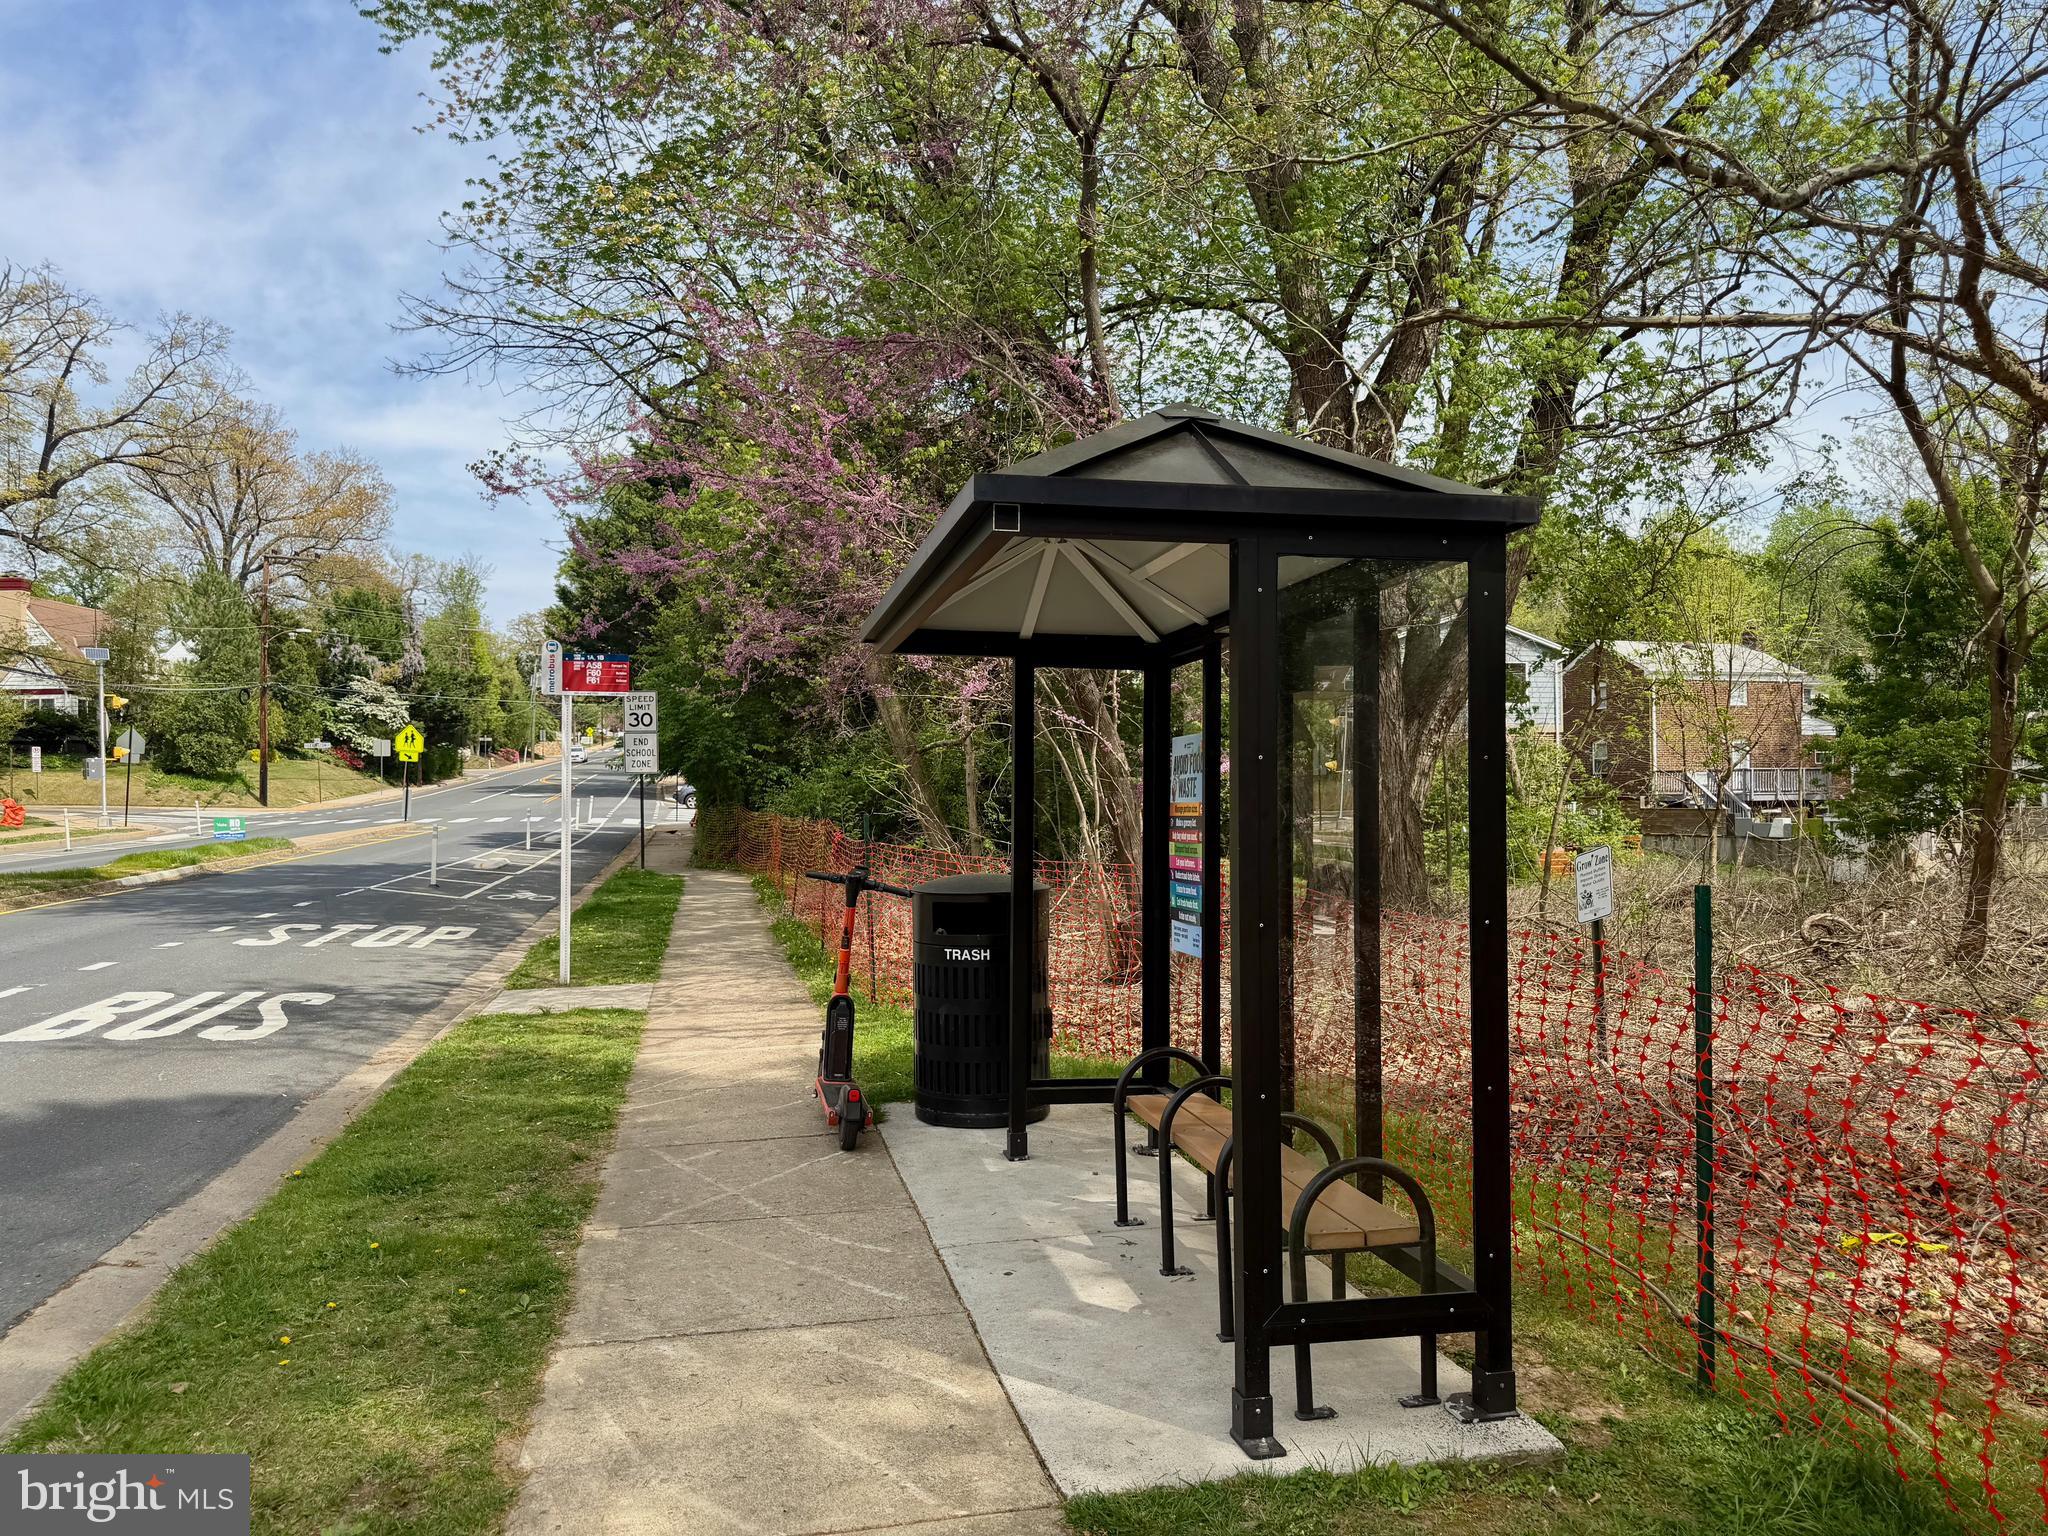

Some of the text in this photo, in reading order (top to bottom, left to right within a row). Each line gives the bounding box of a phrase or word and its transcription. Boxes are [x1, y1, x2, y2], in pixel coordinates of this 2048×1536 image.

[628, 712, 653, 727] 30
[633, 737, 648, 746] END
[626, 748, 656, 757] SCHOOL
[631, 760, 651, 768] ZONE
[1173, 754, 1188, 776] AVOID
[1178, 776, 1197, 798] WASTE
[1595, 855, 1608, 866] Zone
[232, 924, 478, 948] STOP
[944, 948, 990, 961] TRASH
[0, 992, 336, 1041] BUS
